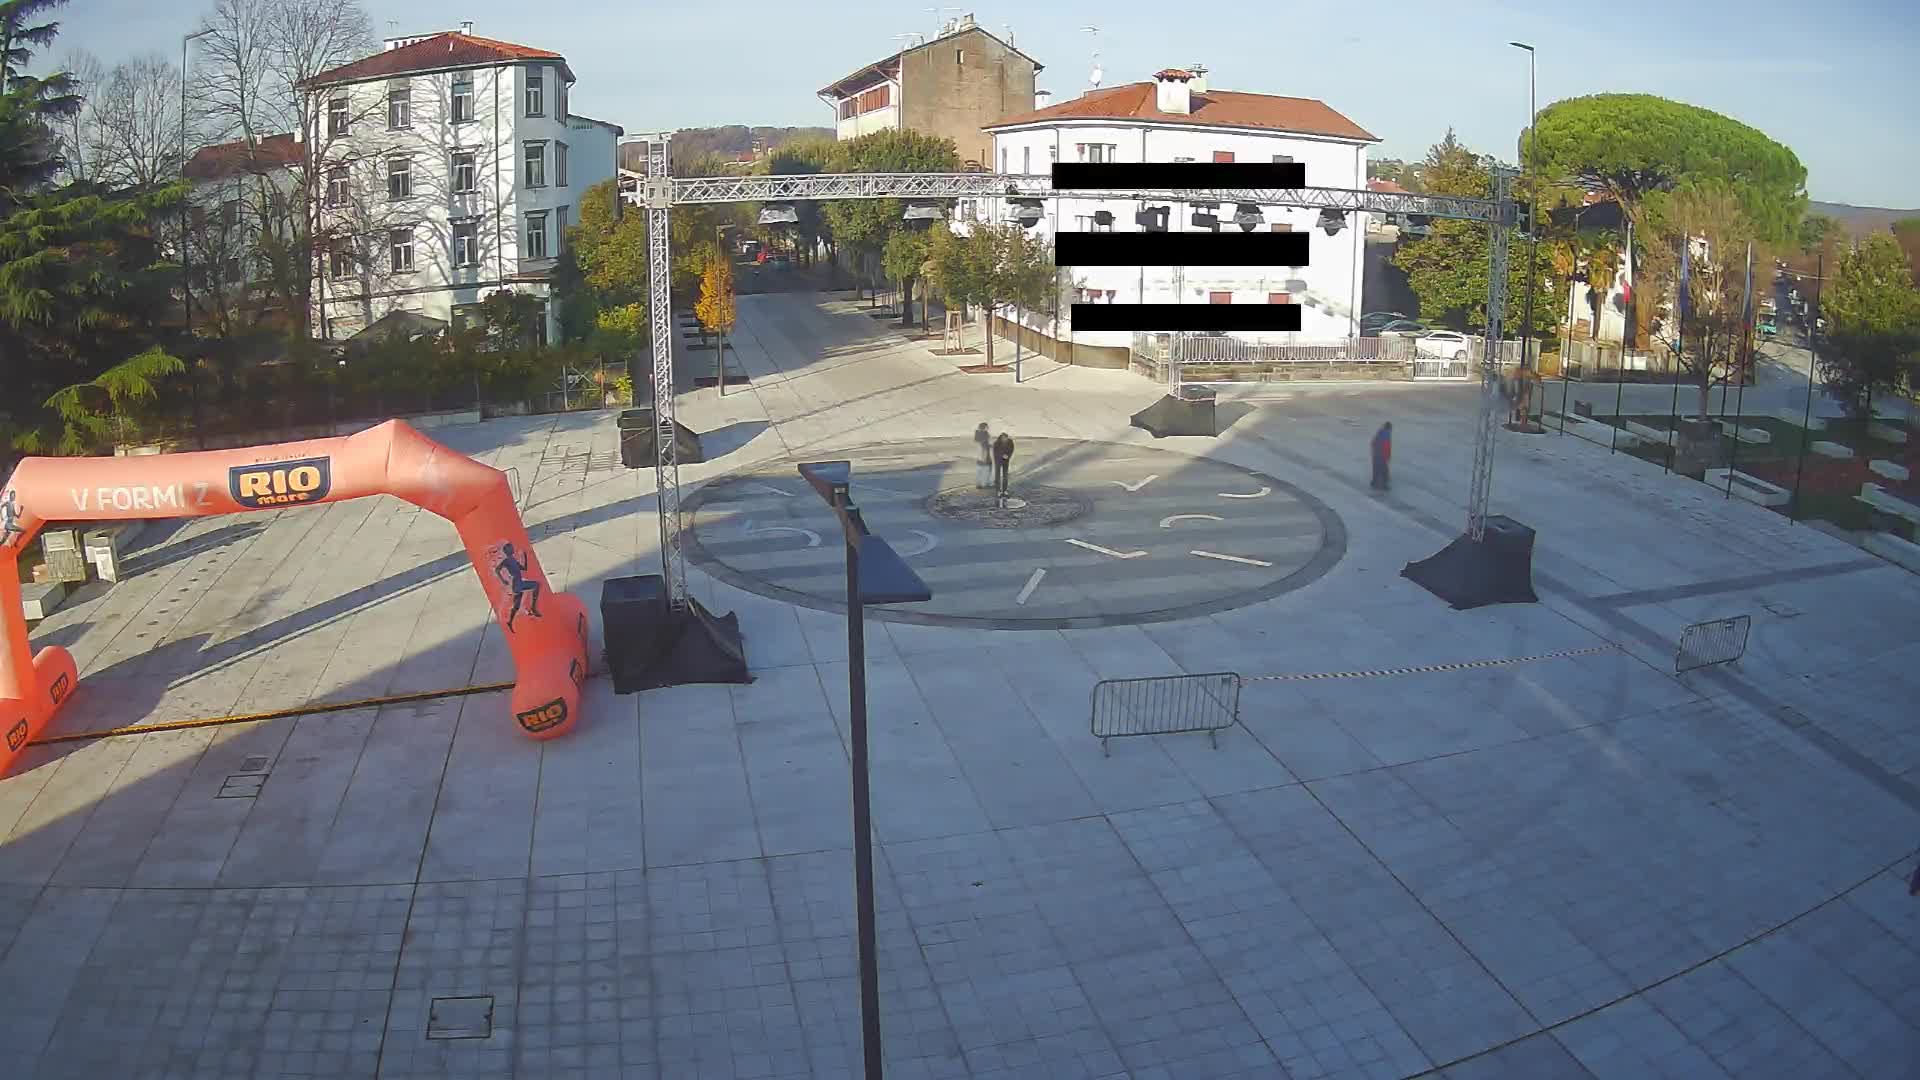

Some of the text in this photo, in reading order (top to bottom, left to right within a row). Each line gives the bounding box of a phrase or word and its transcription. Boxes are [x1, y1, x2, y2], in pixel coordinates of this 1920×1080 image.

[240, 466, 321, 497] RIO
[524, 704, 562, 726] RIO
[8, 723, 27, 748] RIO
